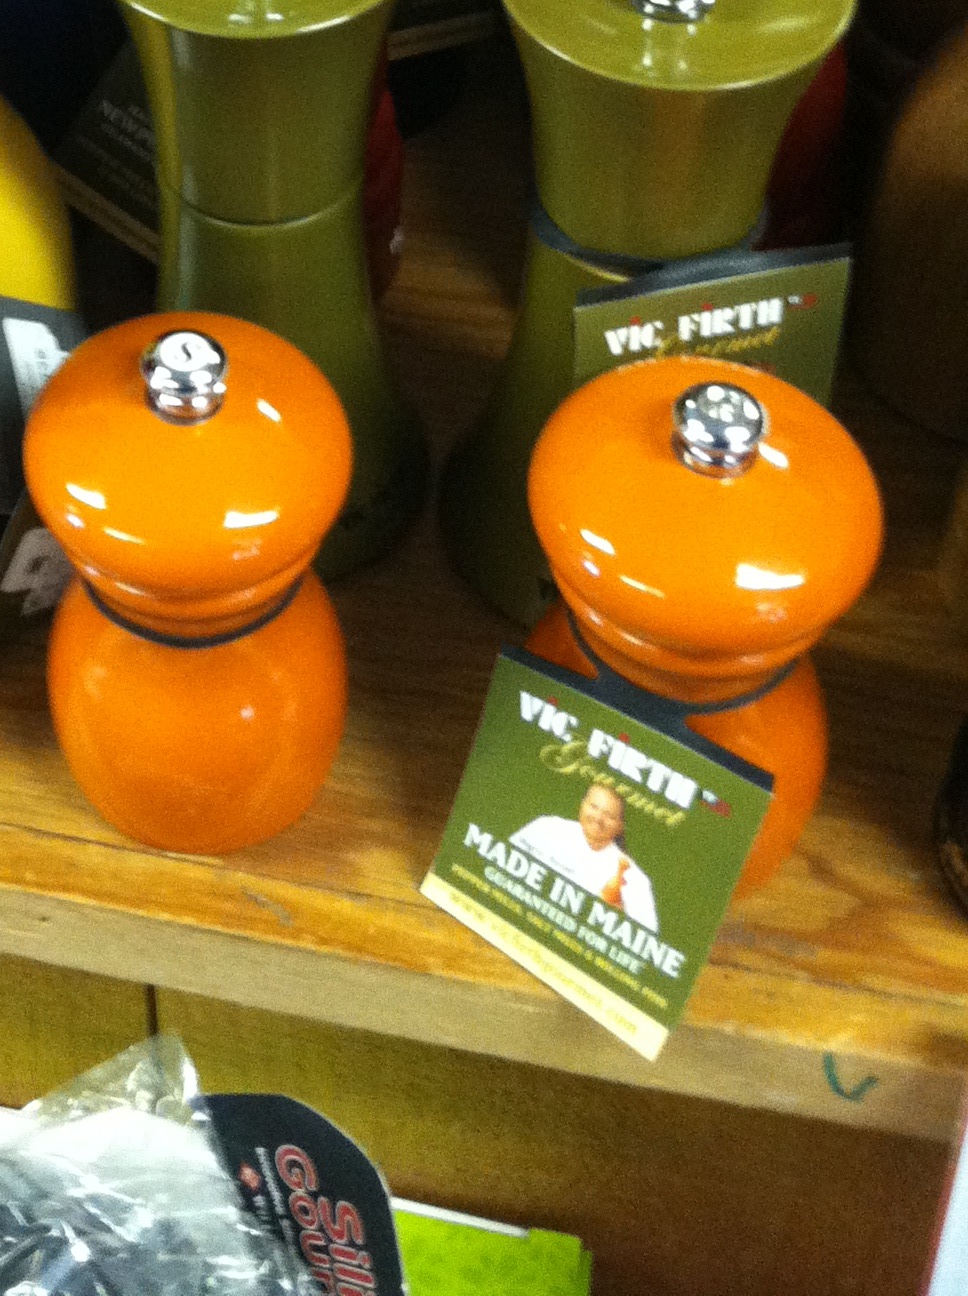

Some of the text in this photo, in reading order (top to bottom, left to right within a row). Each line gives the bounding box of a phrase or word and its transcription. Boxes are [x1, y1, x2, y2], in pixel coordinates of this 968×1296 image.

[604, 296, 783, 356] VIC FIRTH
[519, 689, 700, 810] VIC FIRTH
[463, 822, 548, 891] MADE
[548, 877, 587, 917] IN
[586, 901, 689, 981] MAINE
[483, 864, 646, 975] GUARANTEED FOR LIFE
